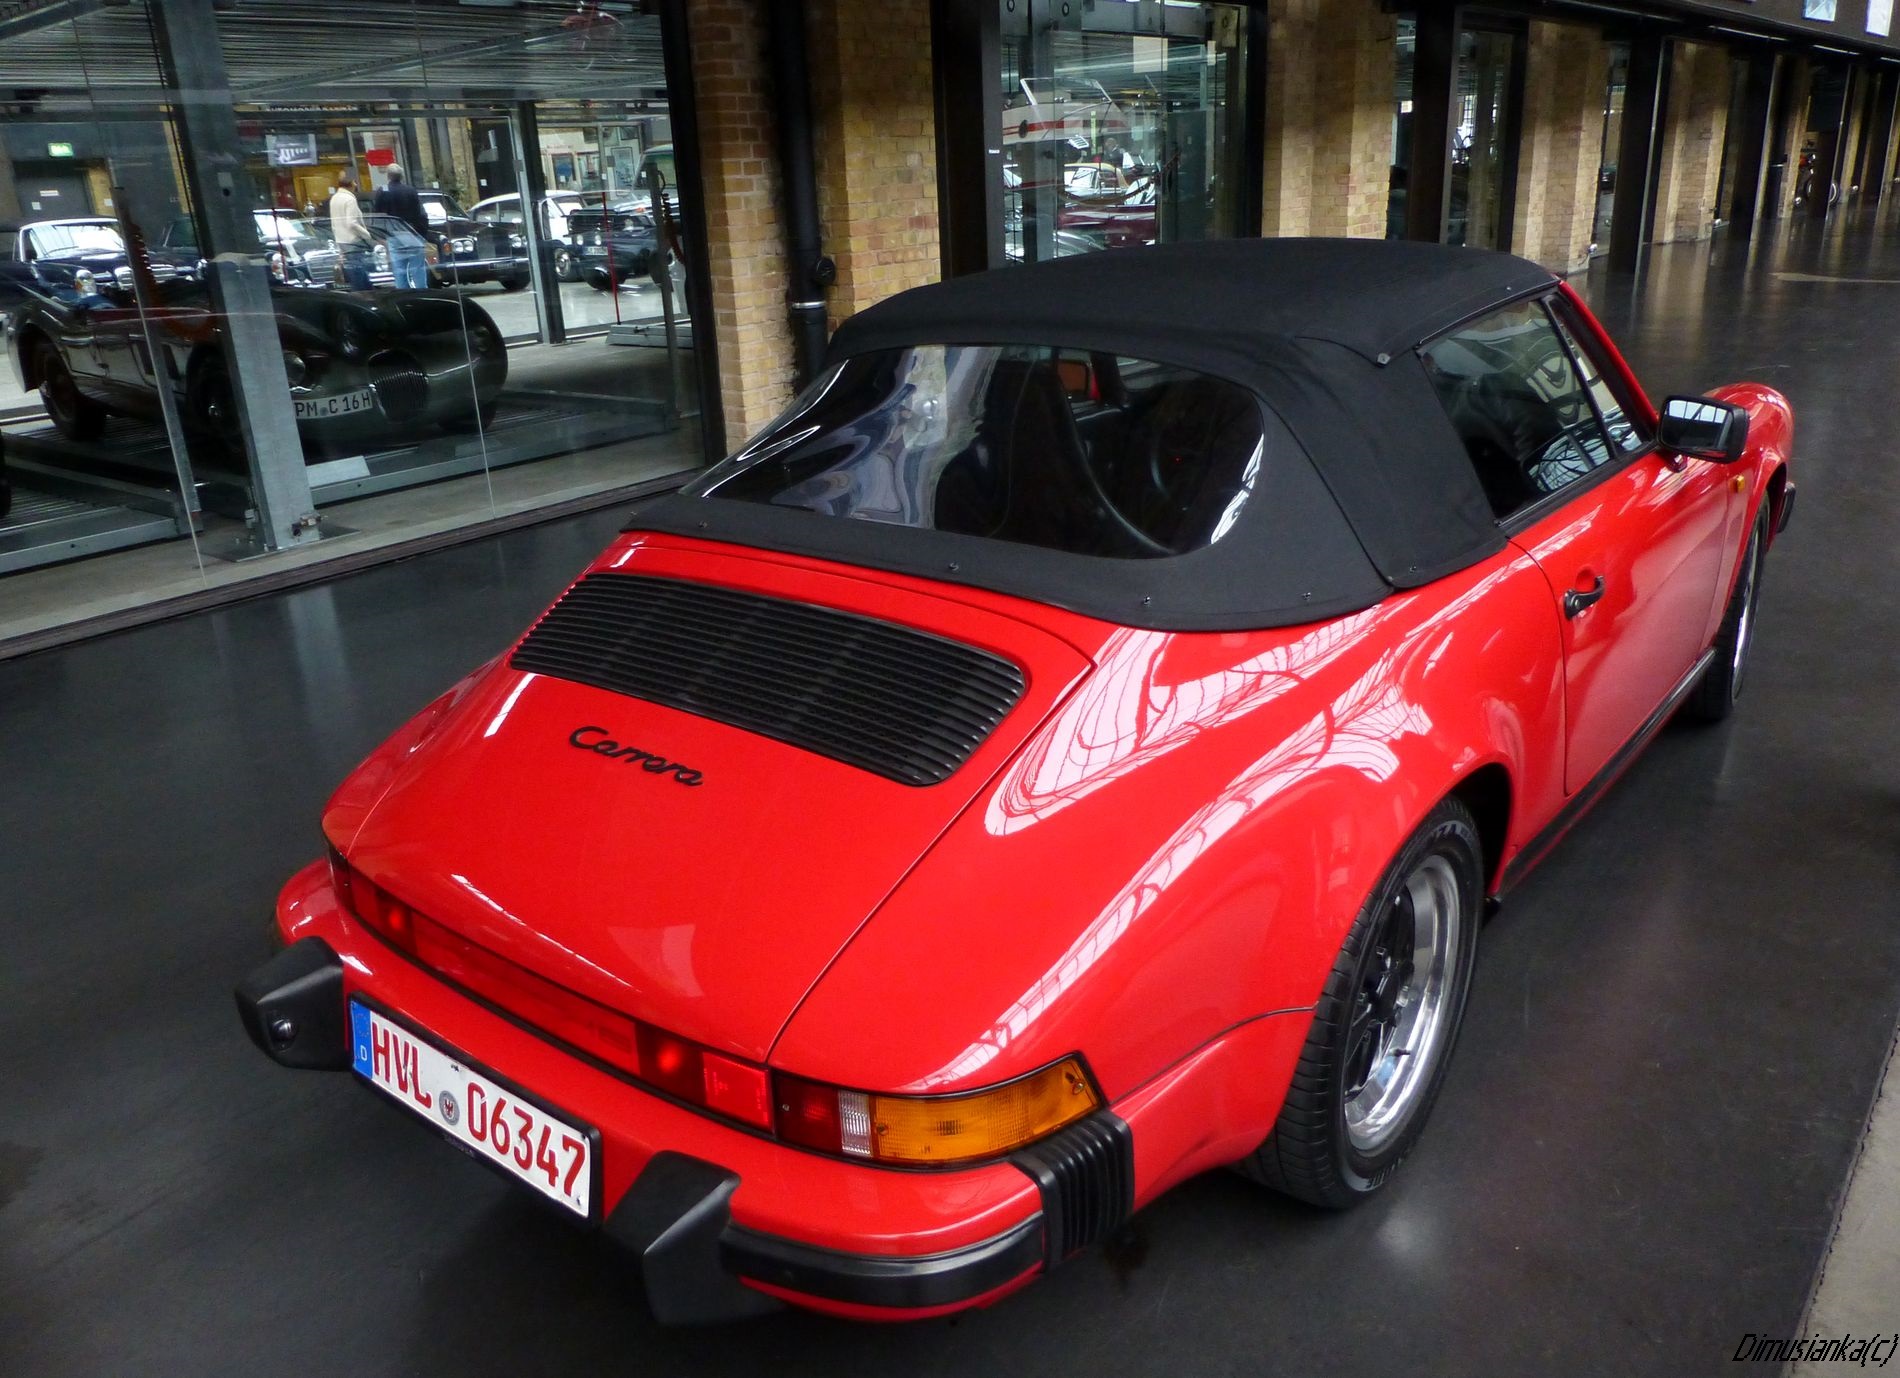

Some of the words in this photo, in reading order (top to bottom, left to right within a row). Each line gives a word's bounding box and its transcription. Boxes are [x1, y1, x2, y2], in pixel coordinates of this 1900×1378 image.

[294, 402, 318, 417] PM
[569, 726, 703, 787] Carrera
[371, 1021, 432, 1109] HVL
[466, 1081, 586, 1197] 06347
